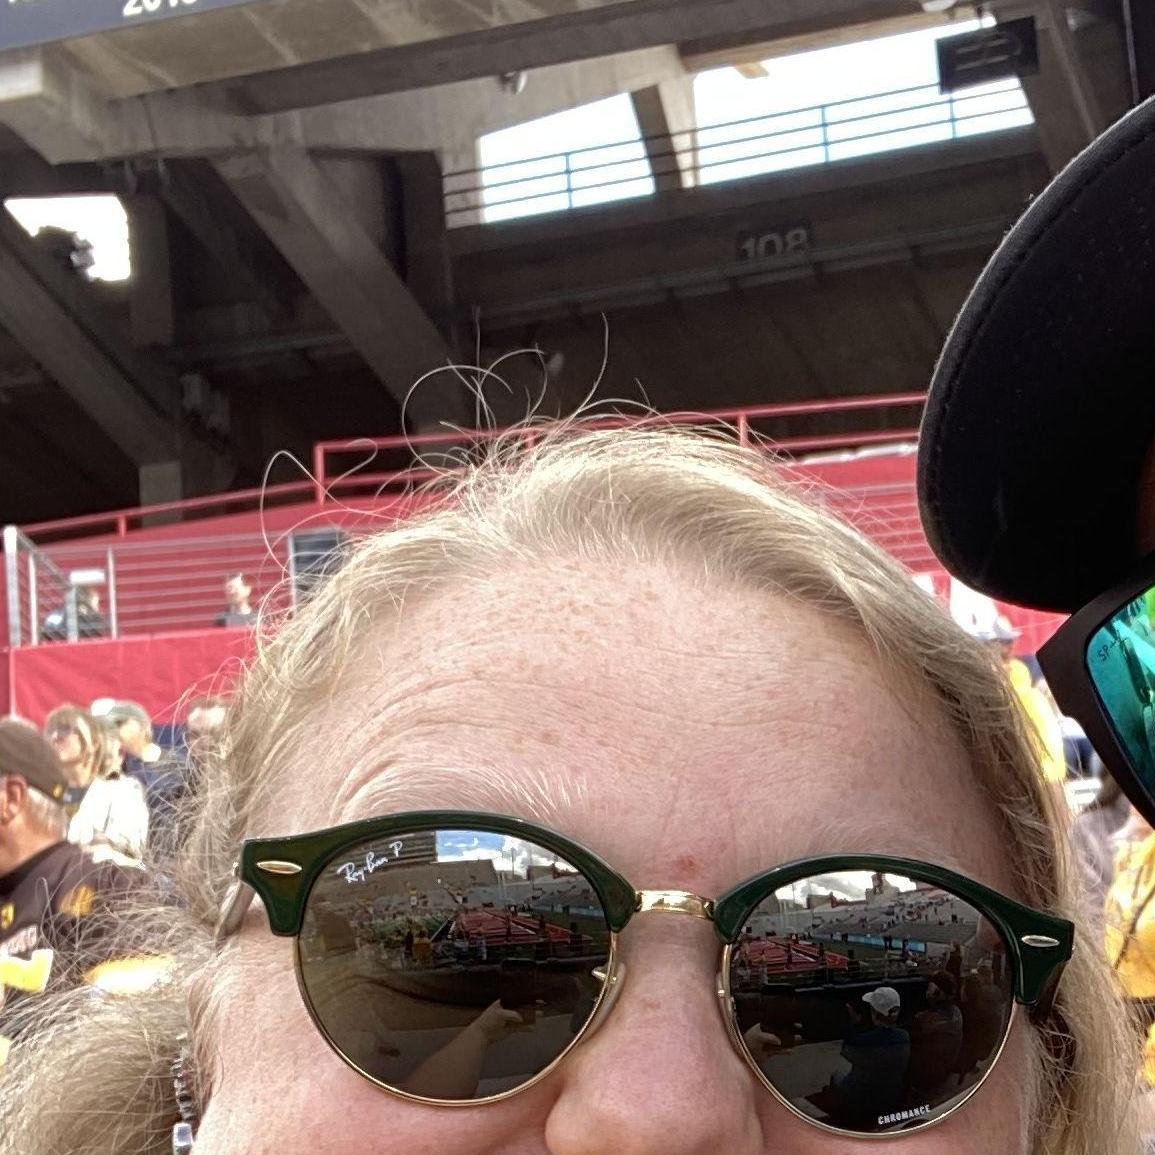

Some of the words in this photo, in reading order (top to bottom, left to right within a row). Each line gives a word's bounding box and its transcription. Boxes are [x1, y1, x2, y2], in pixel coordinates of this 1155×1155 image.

[741, 226, 808, 260] 108
[388, 840, 403, 858] P
[877, 1104, 931, 1125] CHROMANCE
